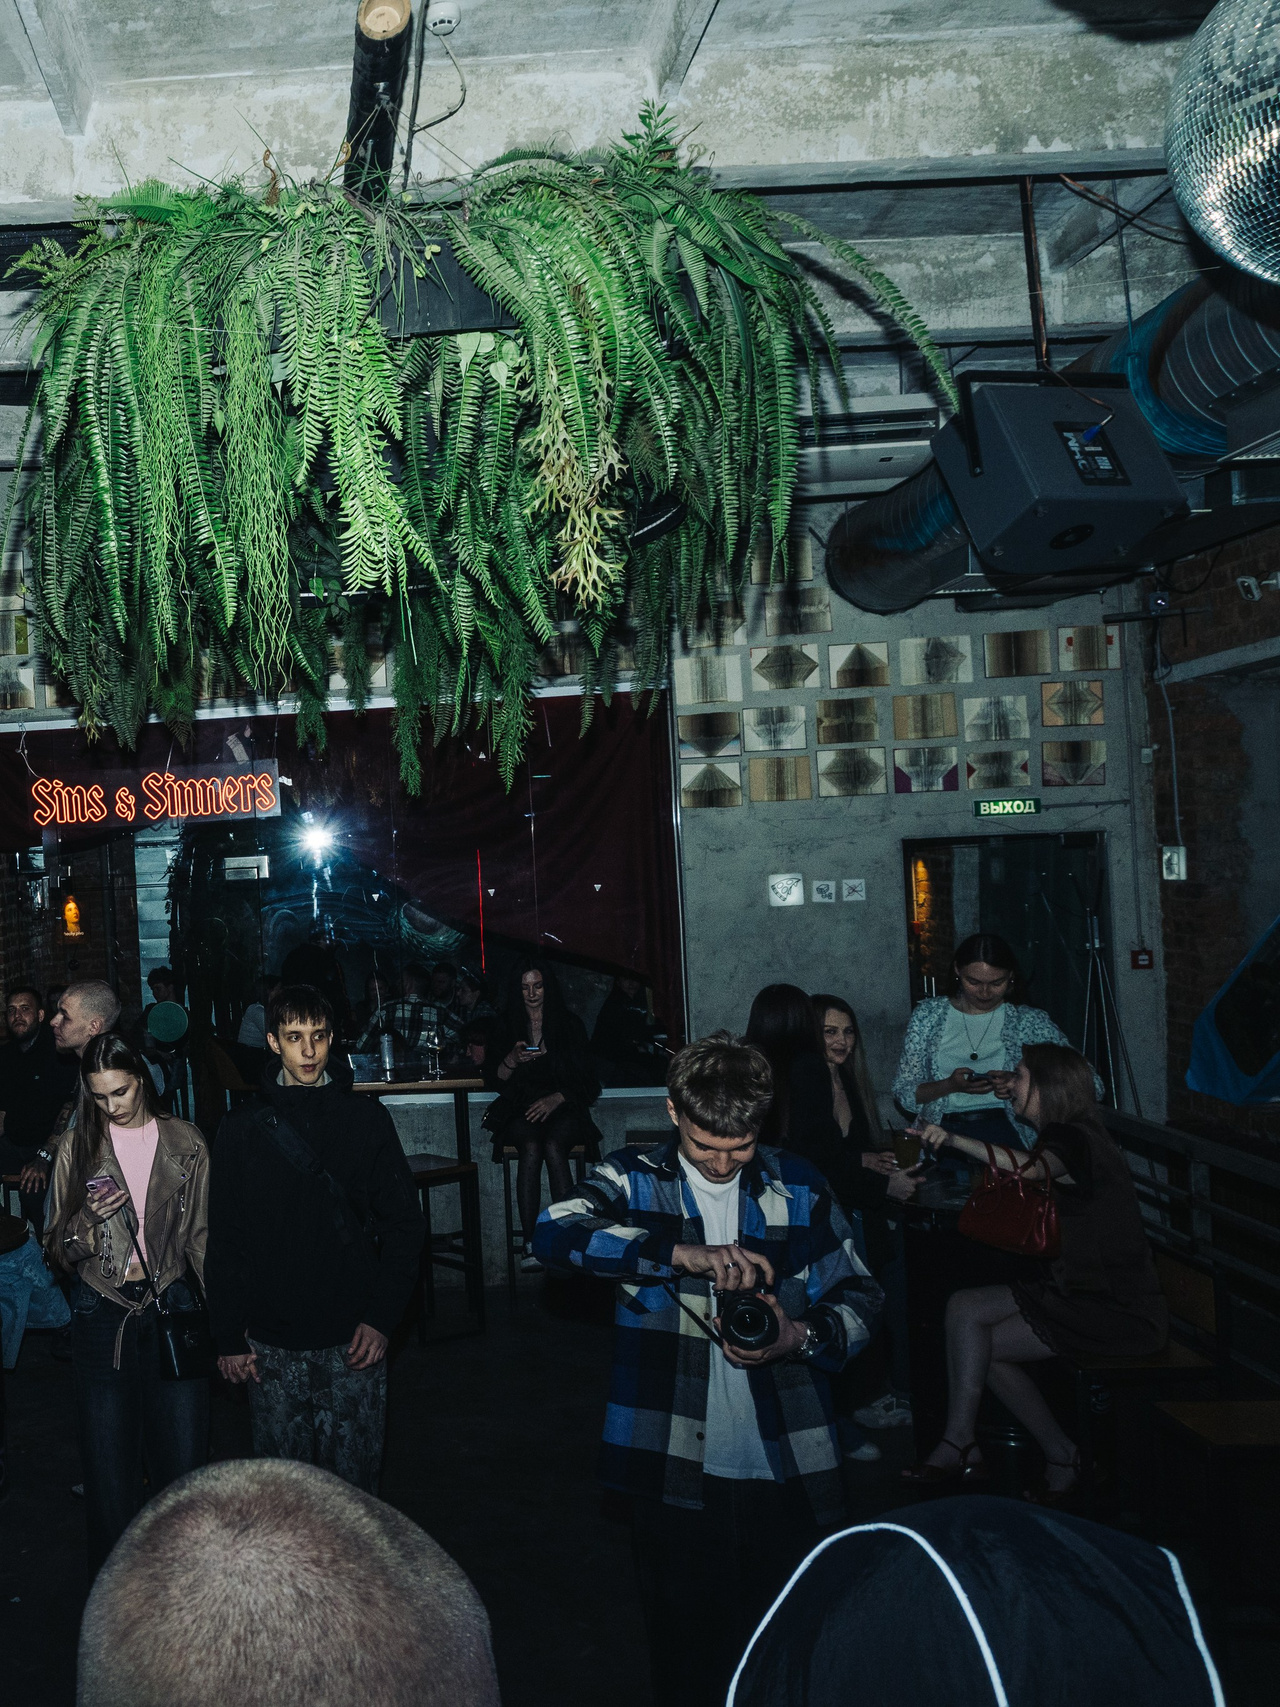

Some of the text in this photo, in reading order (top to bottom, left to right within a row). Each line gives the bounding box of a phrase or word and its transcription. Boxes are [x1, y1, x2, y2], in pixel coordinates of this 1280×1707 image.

[31, 772, 276, 825] Sins & Sinners
[979, 800, 1036, 815] ВЫХОД
